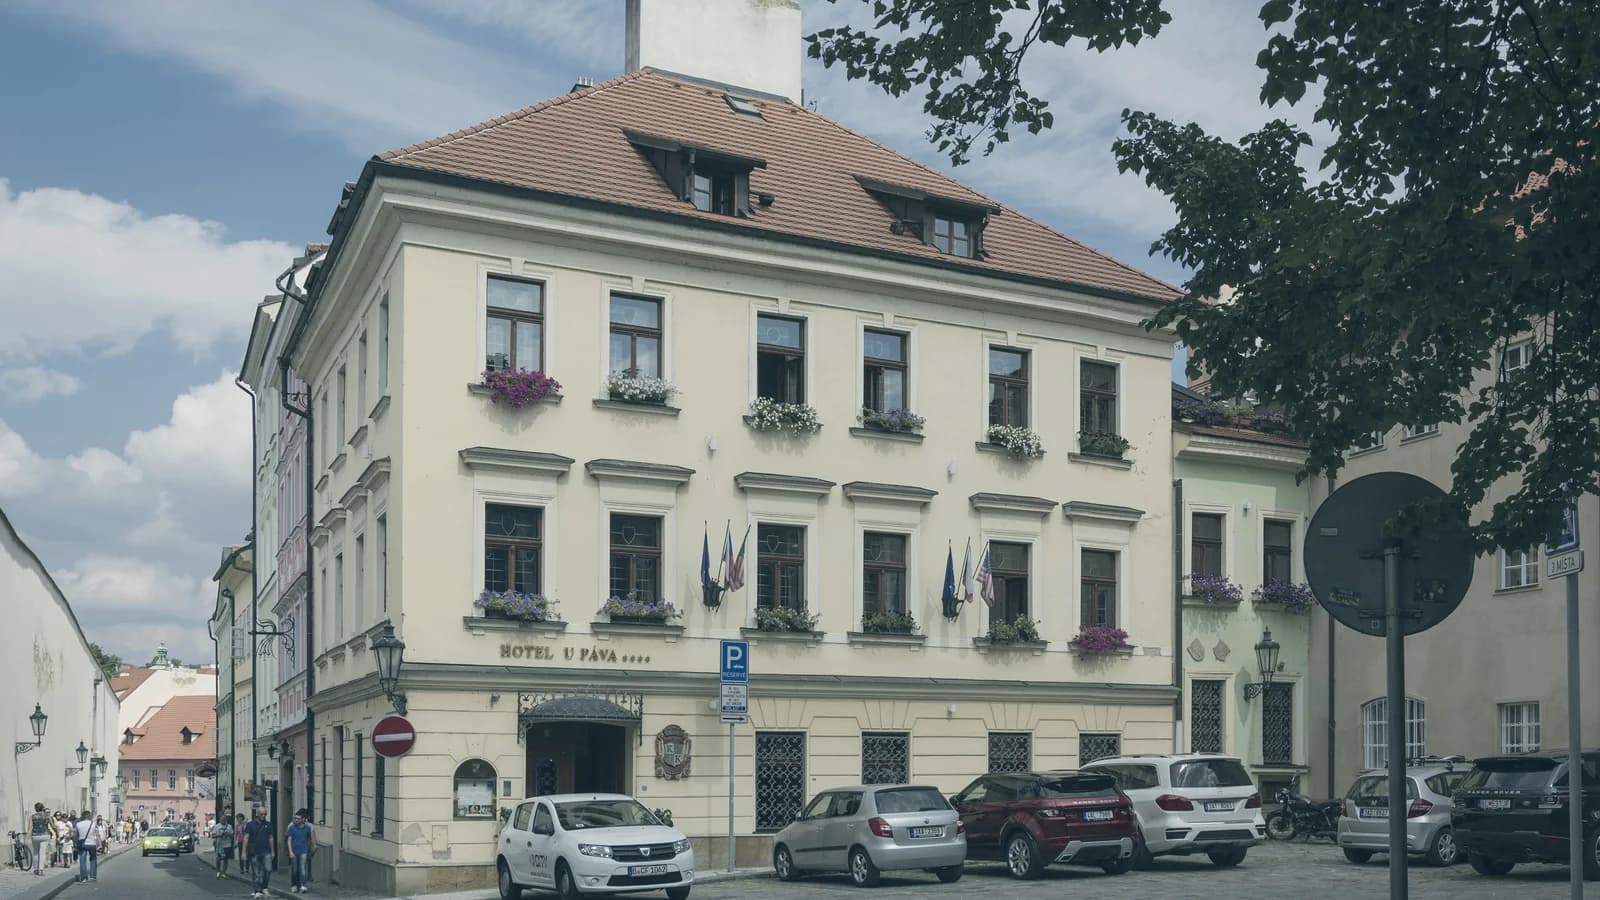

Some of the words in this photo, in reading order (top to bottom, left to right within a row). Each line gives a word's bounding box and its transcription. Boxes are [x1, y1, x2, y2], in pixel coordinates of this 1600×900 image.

[500, 644, 554, 660] HOTEL
[564, 647, 574, 660] U
[580, 645, 617, 663] PÁVA
[727, 645, 743, 669] P
